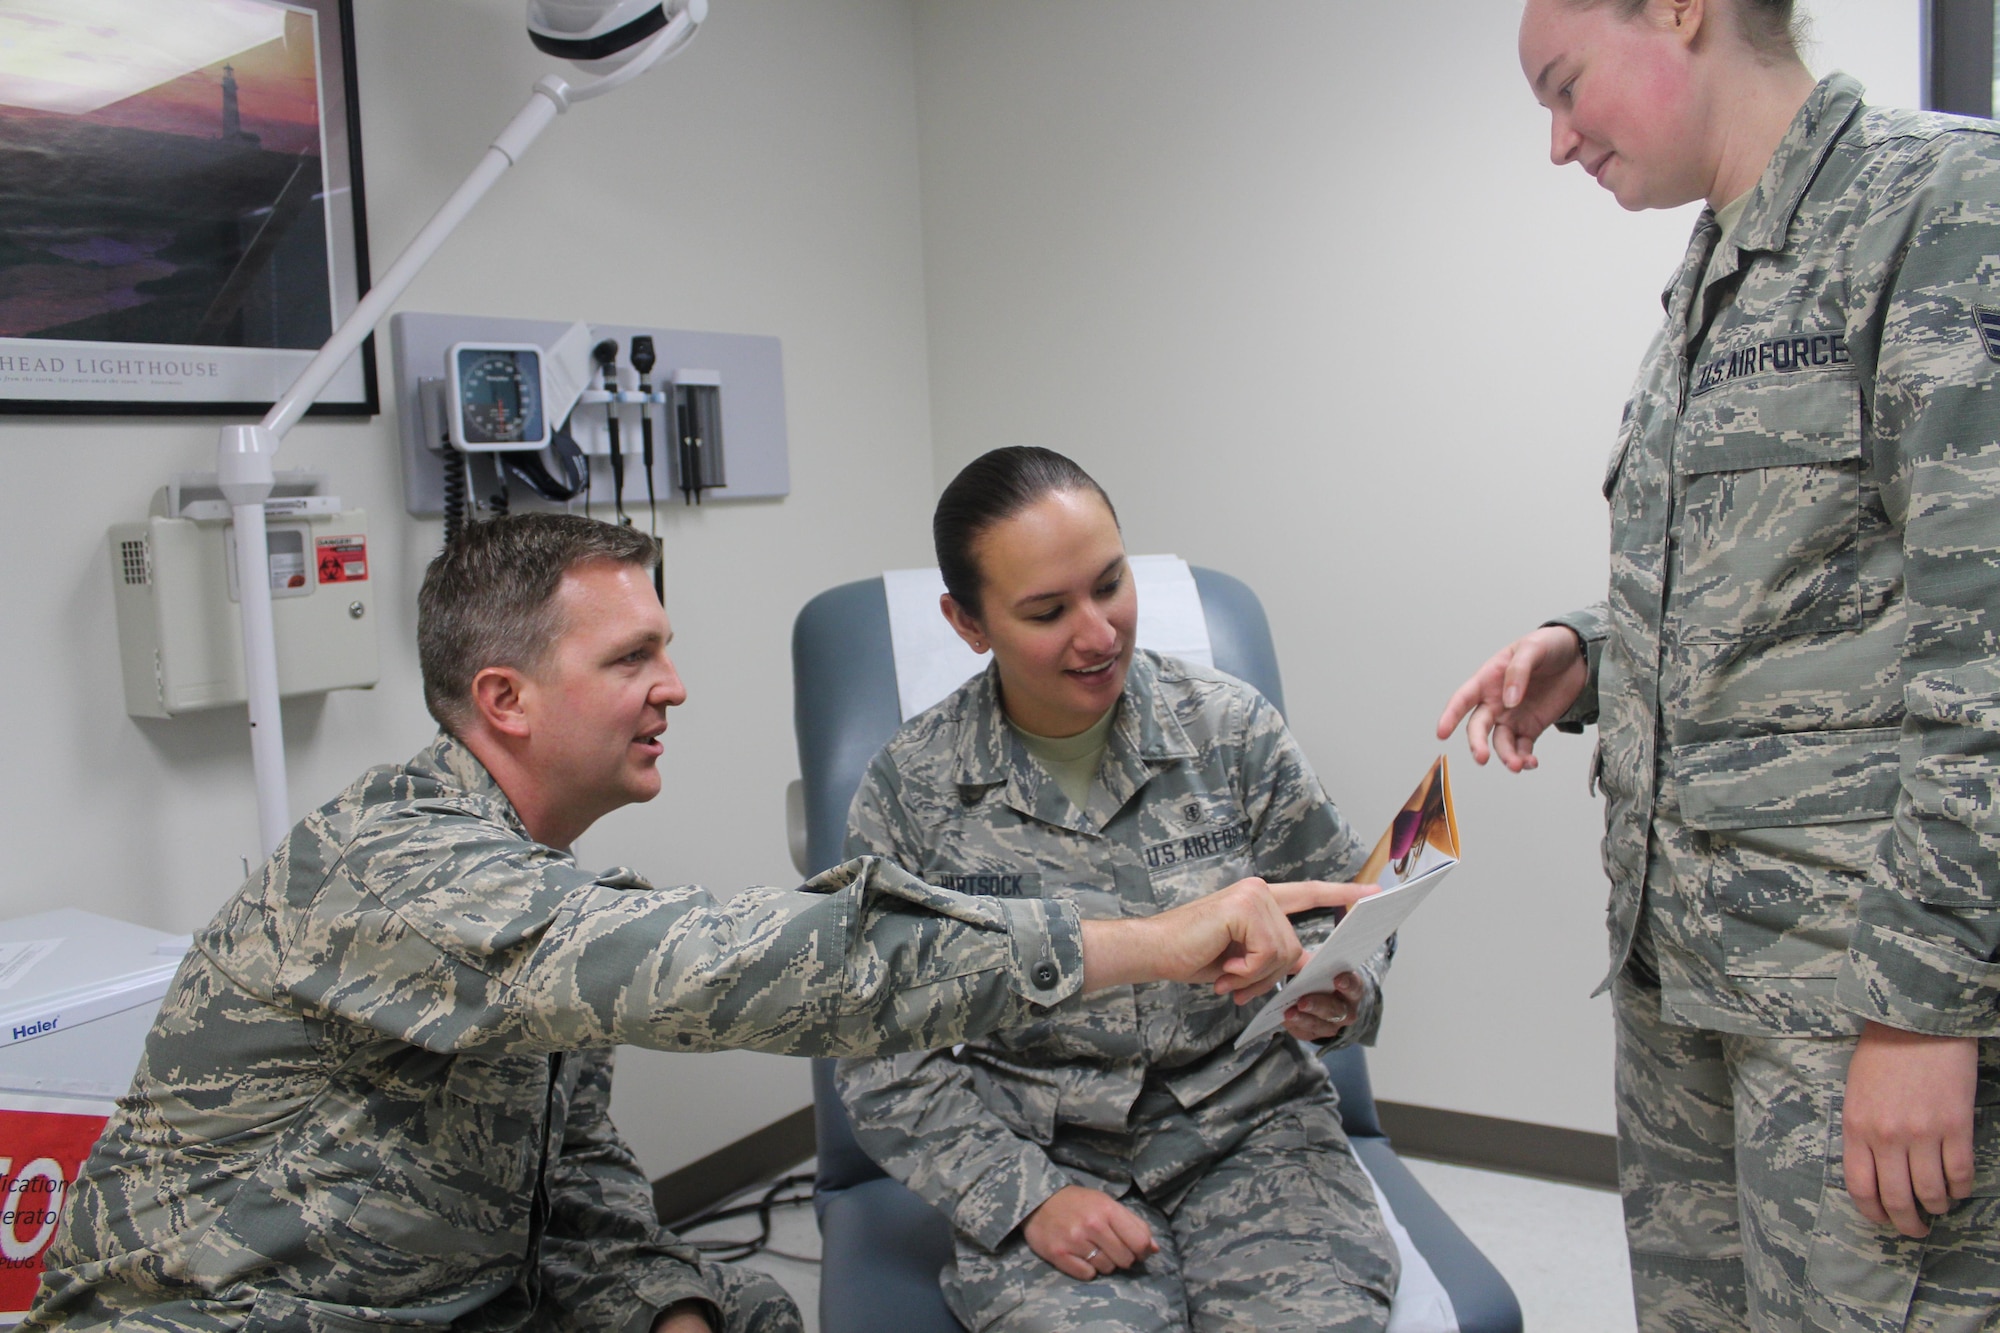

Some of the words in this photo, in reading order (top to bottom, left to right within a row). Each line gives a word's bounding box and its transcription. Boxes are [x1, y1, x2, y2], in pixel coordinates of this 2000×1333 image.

[0, 356, 65, 373] HEAD
[76, 358, 218, 377] LIGHTHOUSE
[1699, 359, 1726, 390] U.S.
[1727, 347, 1757, 380] AIR
[1760, 334, 1850, 372] FORCE
[1146, 843, 1181, 868] U.S.
[1183, 835, 1212, 860] AIR
[13, 1017, 58, 1040] Haier
[0, 1172, 70, 1193] ication
[0, 1207, 60, 1225] erato
